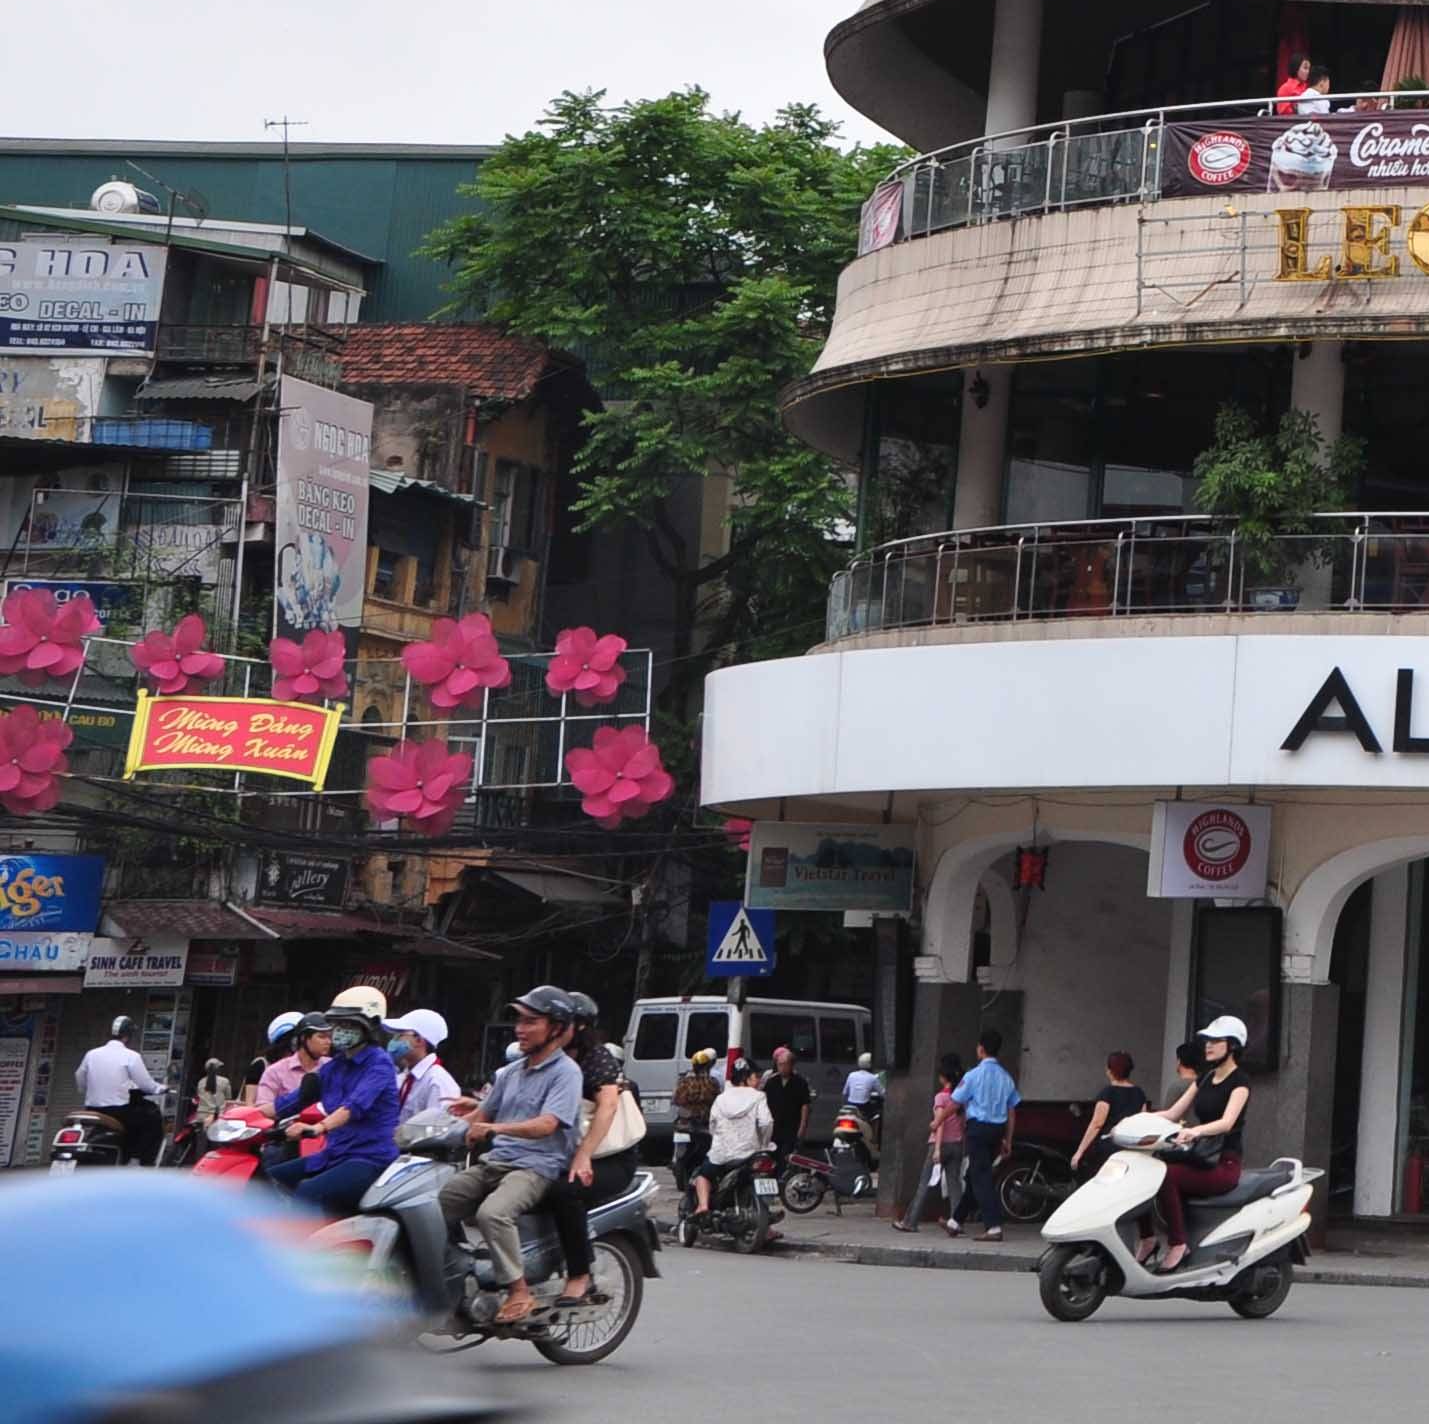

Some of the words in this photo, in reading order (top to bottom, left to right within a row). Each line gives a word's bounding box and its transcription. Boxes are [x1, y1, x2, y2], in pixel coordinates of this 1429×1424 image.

[1194, 135, 1246, 154] HIGHLANDS
[1201, 170, 1234, 182] COFFEE
[34, 249, 149, 278] HOA
[39, 300, 104, 320] DECAL
[123, 303, 146, 321] IN
[298, 504, 331, 534] DECAL
[243, 738, 309, 760] Xuân
[1198, 863, 1235, 876] COFFEE
[90, 956, 118, 970] SINH
[119, 956, 145, 970] CAFE
[146, 955, 182, 970] TRAVEL
